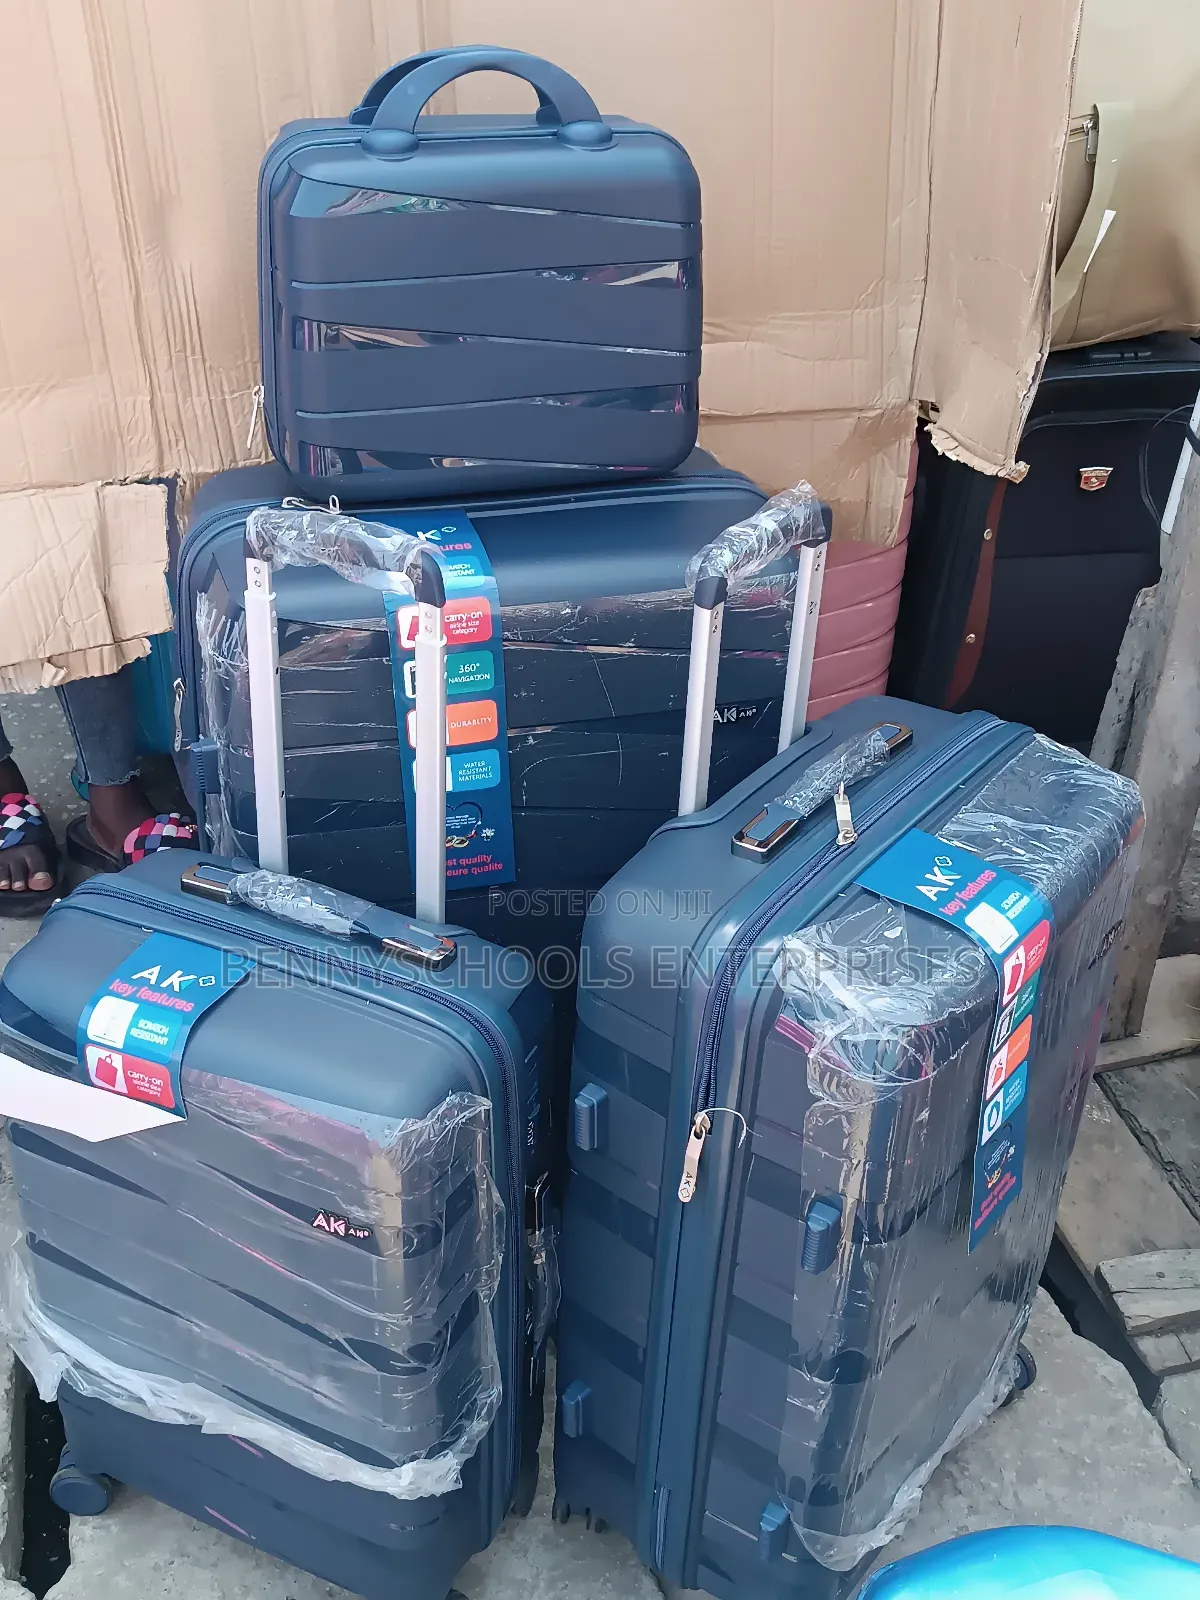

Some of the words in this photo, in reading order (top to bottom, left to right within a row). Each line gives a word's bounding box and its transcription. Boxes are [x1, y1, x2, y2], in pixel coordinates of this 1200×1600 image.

[444, 611, 483, 623] carry-on
[448, 672, 491, 684] NAVIGATION
[713, 707, 737, 723] AK
[458, 766, 492, 776] RESISTANT
[464, 760, 486, 769] WATER
[458, 772, 493, 782] MATERIALS
[459, 854, 492, 867] quality
[915, 866, 962, 902] AK
[939, 897, 966, 915] key
[955, 869, 997, 901] features
[131, 964, 197, 993] AK
[109, 978, 135, 997] key
[135, 985, 195, 1012] features
[127, 1070, 163, 1087] carry-on
[312, 1212, 346, 1237] AK
